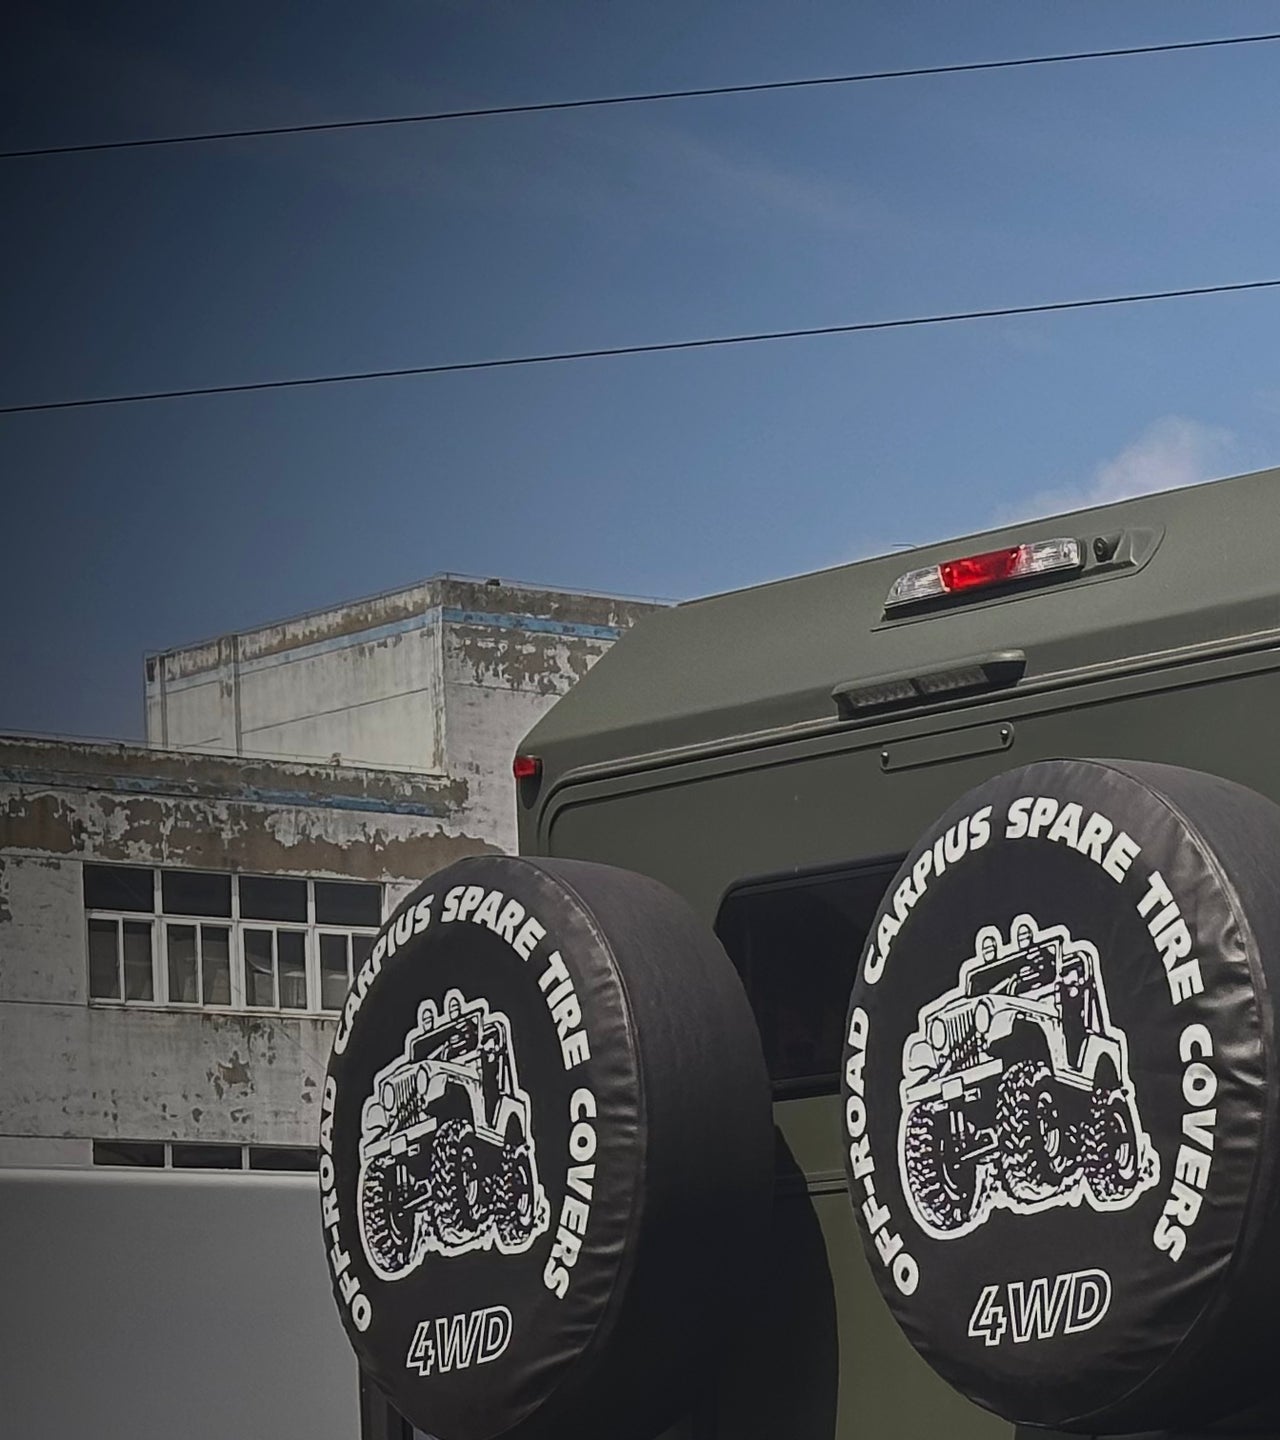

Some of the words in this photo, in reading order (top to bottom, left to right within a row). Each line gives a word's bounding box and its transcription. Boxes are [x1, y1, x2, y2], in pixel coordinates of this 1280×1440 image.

[863, 805, 993, 985] CARPIUS
[1005, 796, 1142, 884] SPARE
[334, 894, 435, 1055] CARPIUS
[440, 885, 547, 962] SPARE
[1136, 870, 1205, 1006] TIRE
[538, 950, 591, 1071] TIRE
[319, 1075, 372, 1332] OFF-ROAD
[543, 1088, 597, 1300] COVERS
[845, 1007, 919, 1296] OFF-ROAD
[1153, 1023, 1218, 1263] COVERS
[406, 1305, 513, 1377] 4WD
[967, 1268, 1113, 1347] 4WD
